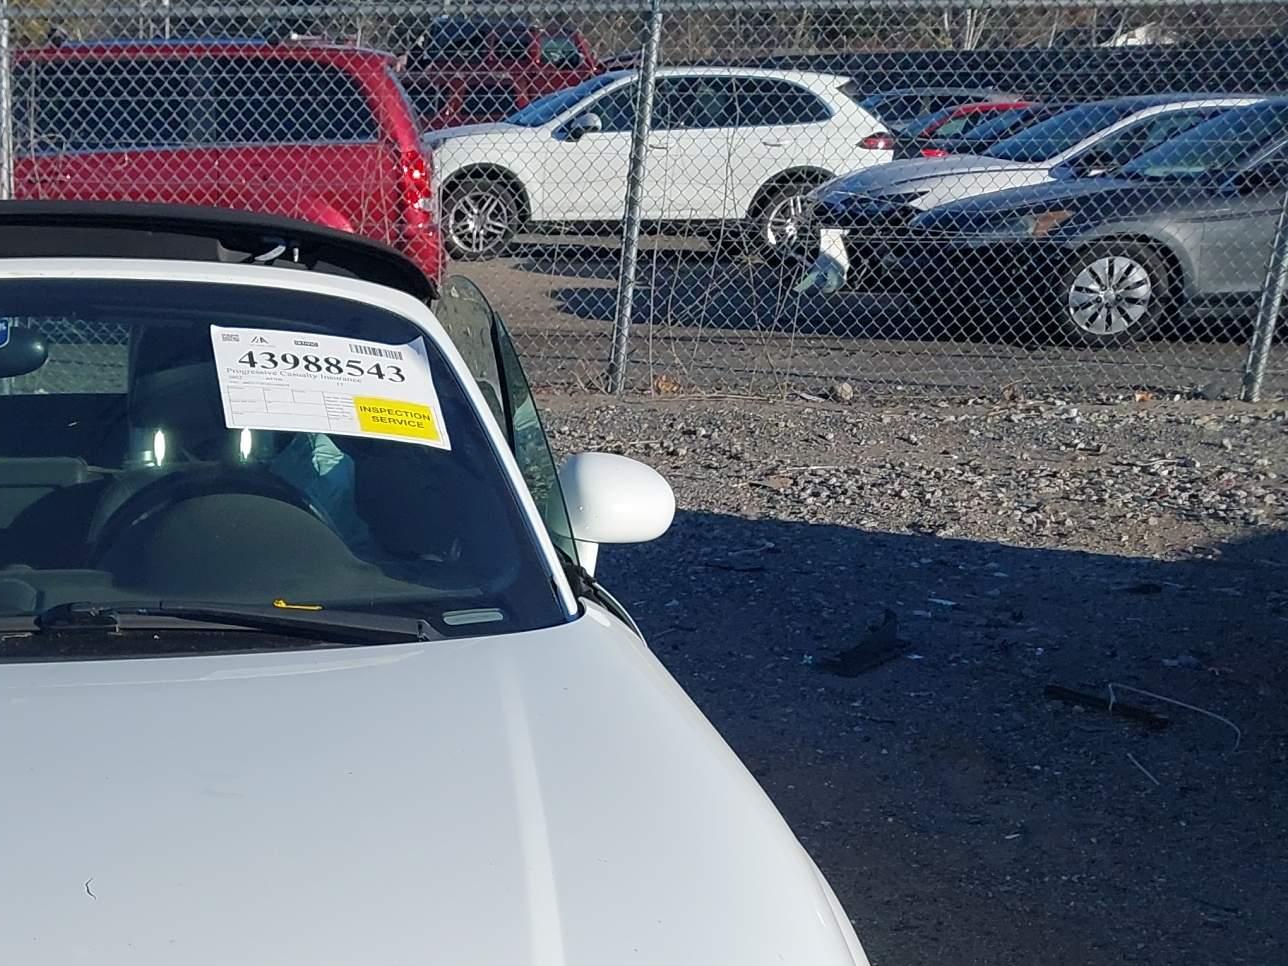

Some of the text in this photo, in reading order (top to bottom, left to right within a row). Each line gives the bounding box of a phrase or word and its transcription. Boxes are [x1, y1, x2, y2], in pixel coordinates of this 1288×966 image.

[238, 350, 406, 383] 43988543
[226, 367, 278, 377] Progressive
[280, 370, 318, 380] Casualty
[321, 373, 363, 383] Insurance
[359, 405, 431, 421] INSPECTION
[371, 415, 425, 429] SERVICE
